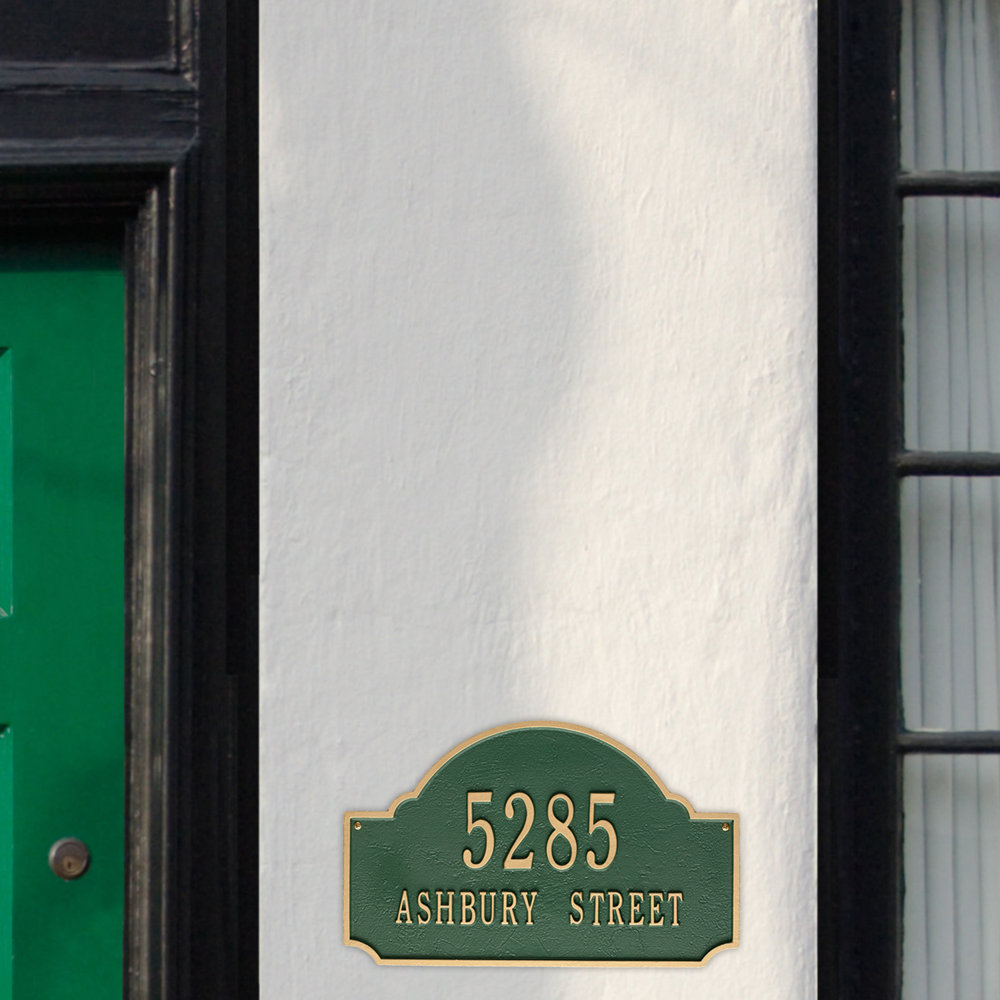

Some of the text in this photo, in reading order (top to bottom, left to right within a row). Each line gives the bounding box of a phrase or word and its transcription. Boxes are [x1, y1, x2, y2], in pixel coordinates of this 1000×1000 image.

[462, 791, 618, 871] 5285
[396, 890, 684, 927] ASHBURY STREET
